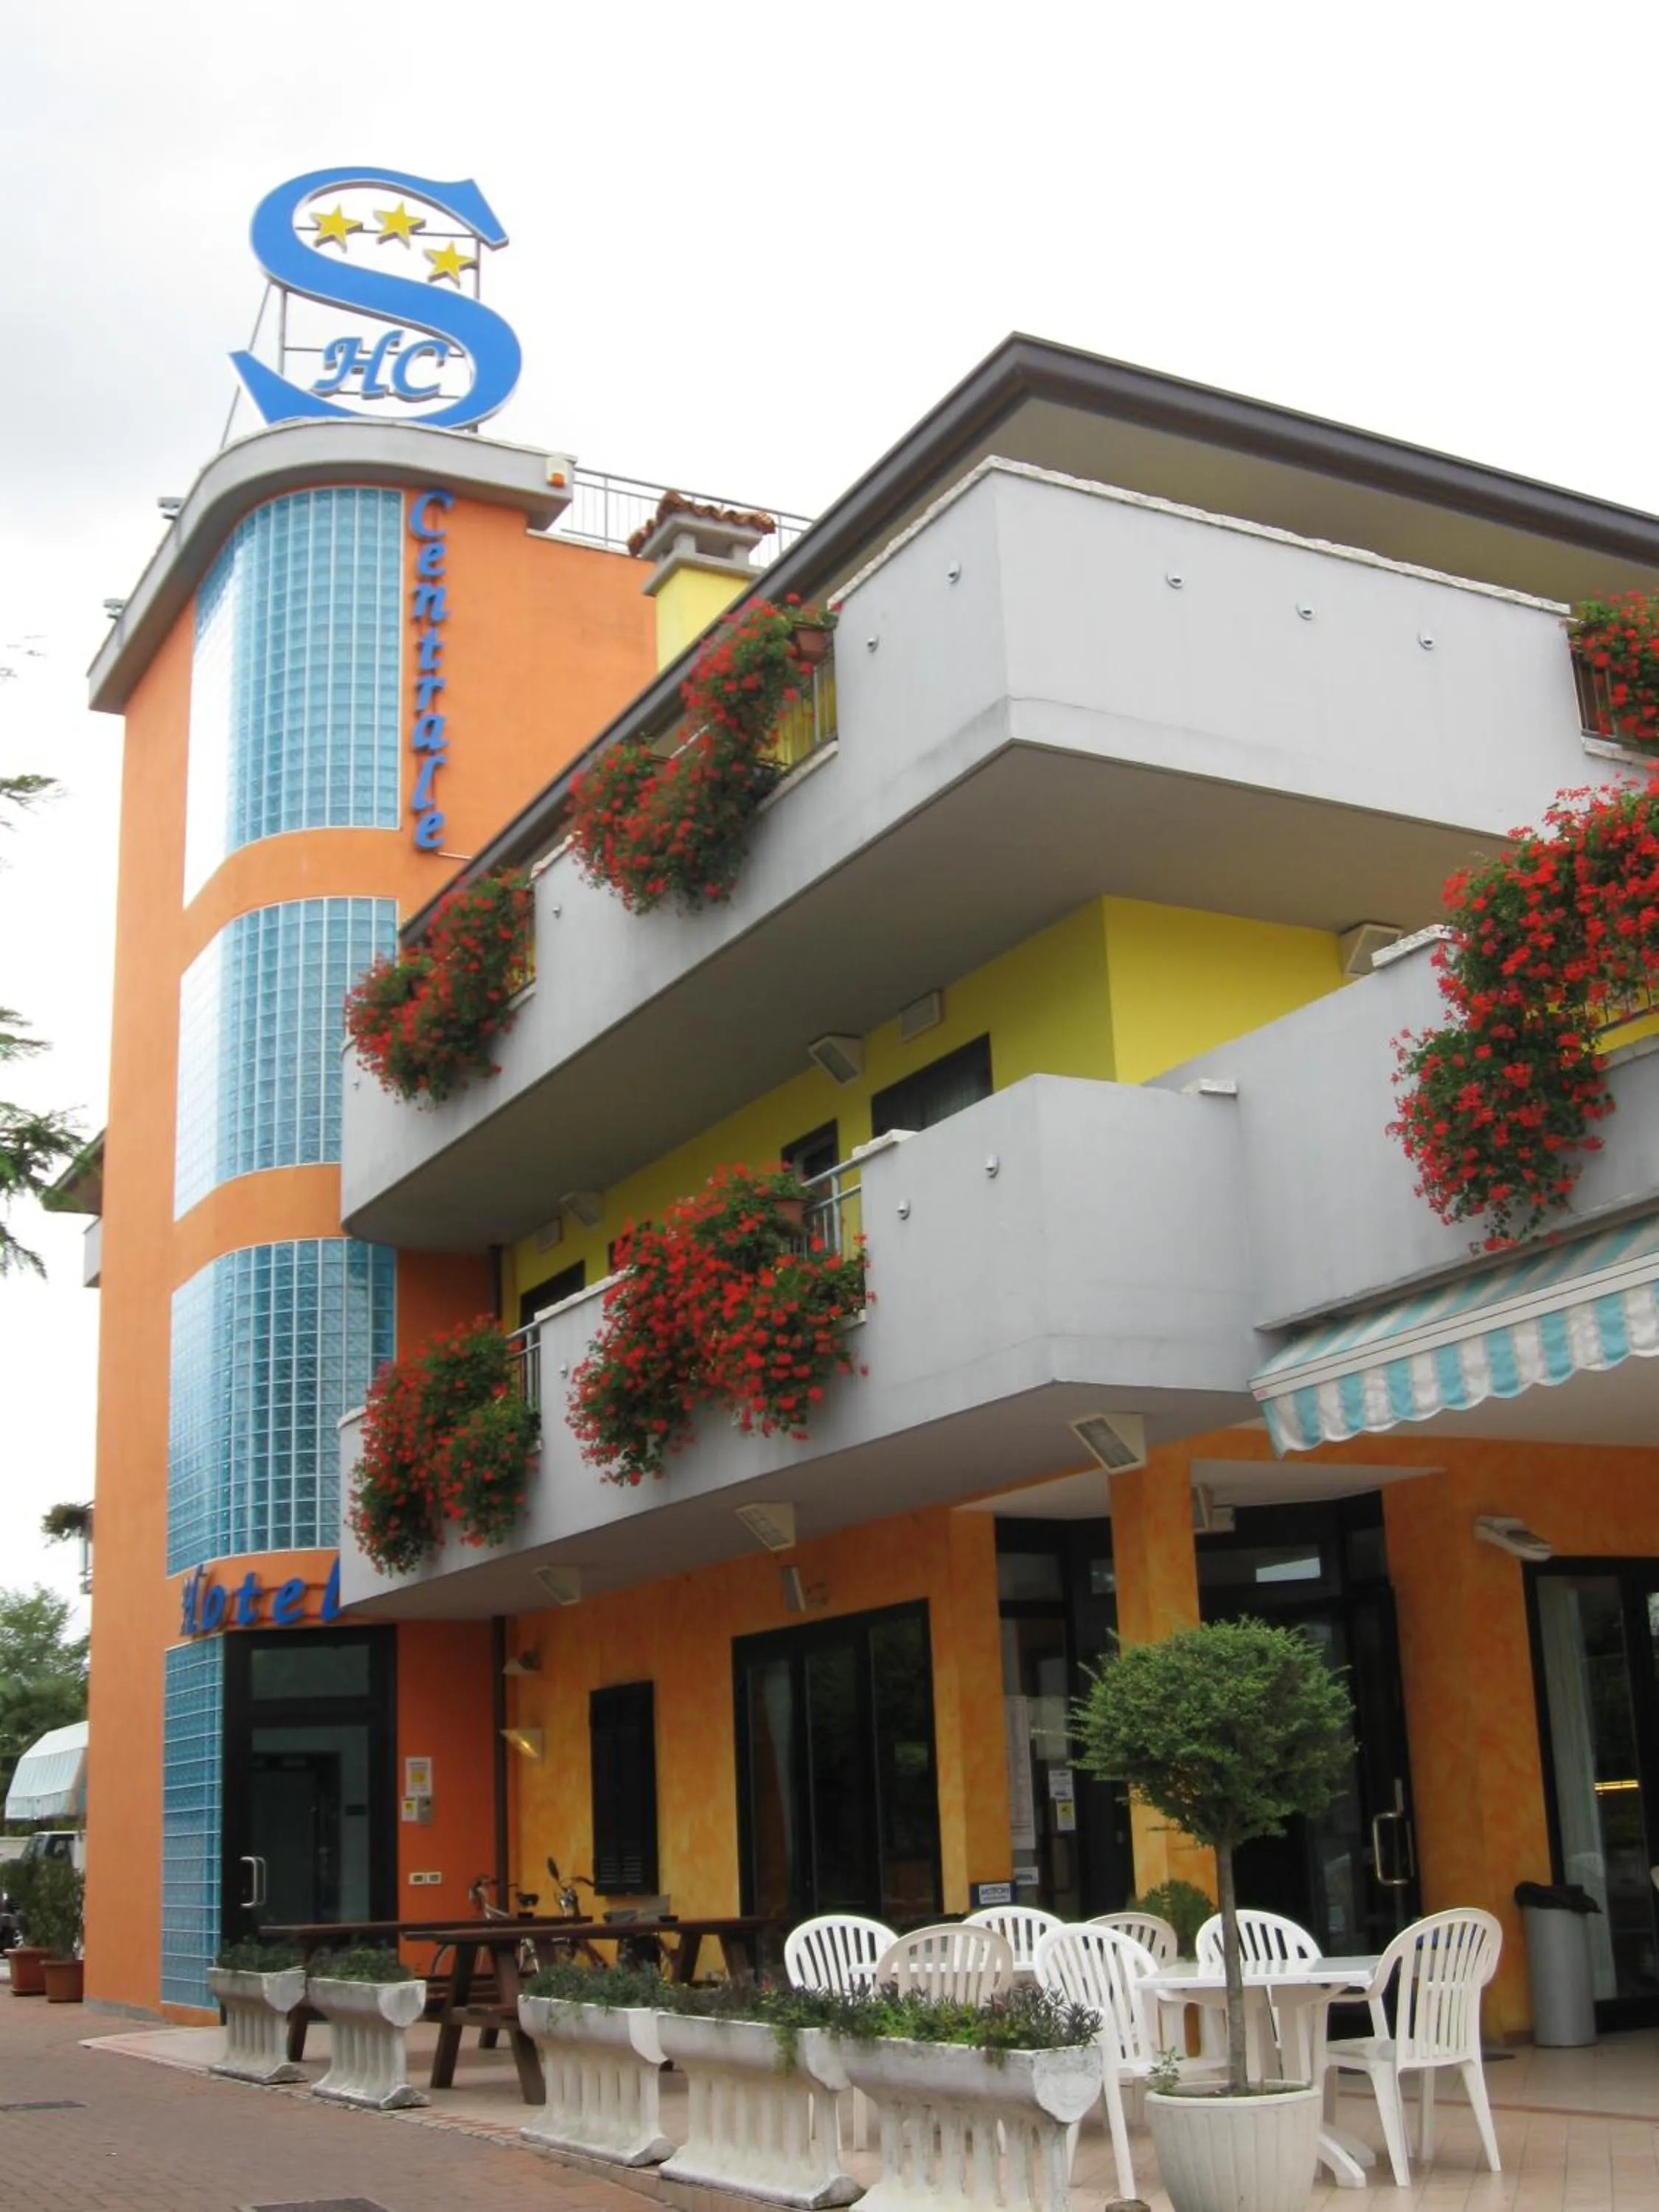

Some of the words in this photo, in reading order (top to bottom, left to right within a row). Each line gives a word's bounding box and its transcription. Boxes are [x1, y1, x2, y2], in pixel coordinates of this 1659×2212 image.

[310, 330, 451, 403] HC
[408, 488, 453, 851] Centrale
[181, 1557, 342, 1636] Hotel
